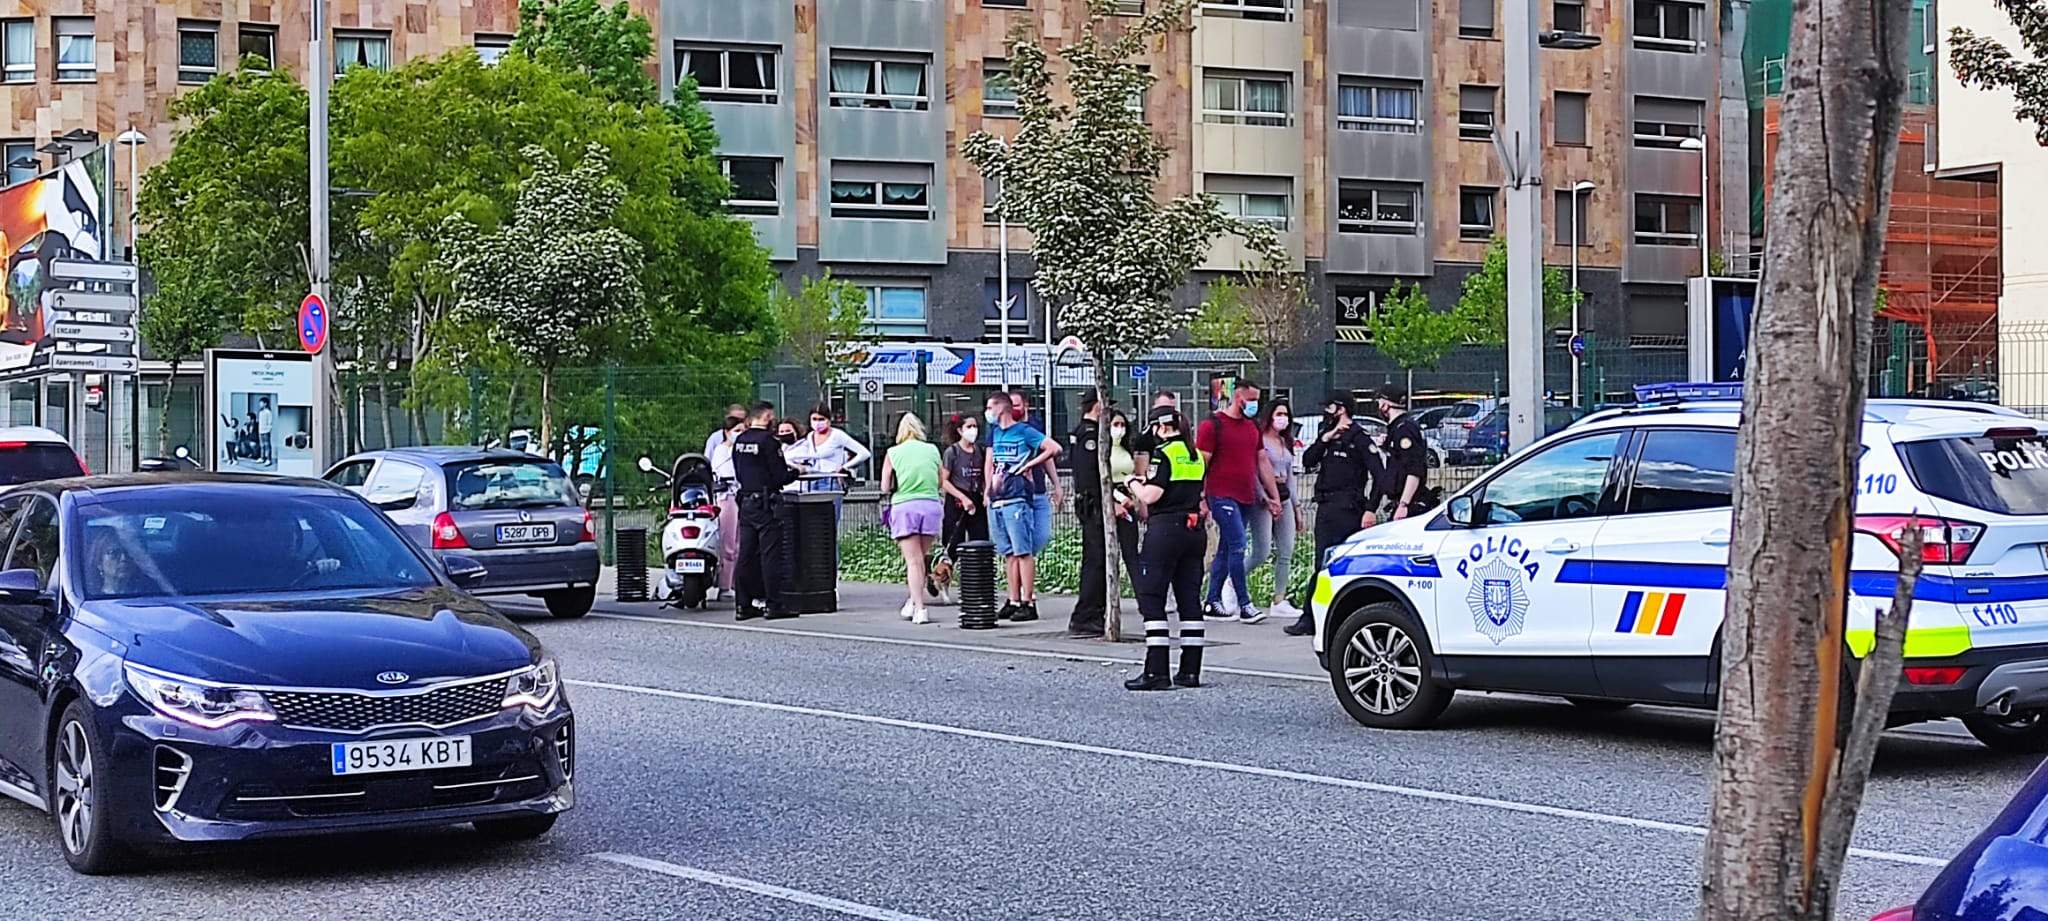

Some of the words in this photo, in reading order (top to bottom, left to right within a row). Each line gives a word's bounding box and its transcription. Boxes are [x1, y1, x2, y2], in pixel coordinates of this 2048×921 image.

[1864, 474, 1896, 494] 110
[504, 527, 527, 538] 5287
[1366, 543, 1424, 551] www.policia.ad
[1456, 535, 1540, 582] POLICIA
[1408, 580, 1432, 589] P-100
[1985, 604, 2018, 625] 110
[382, 671, 403, 682] KIA
[350, 744, 411, 769] 9534
[421, 740, 465, 764] KBT
